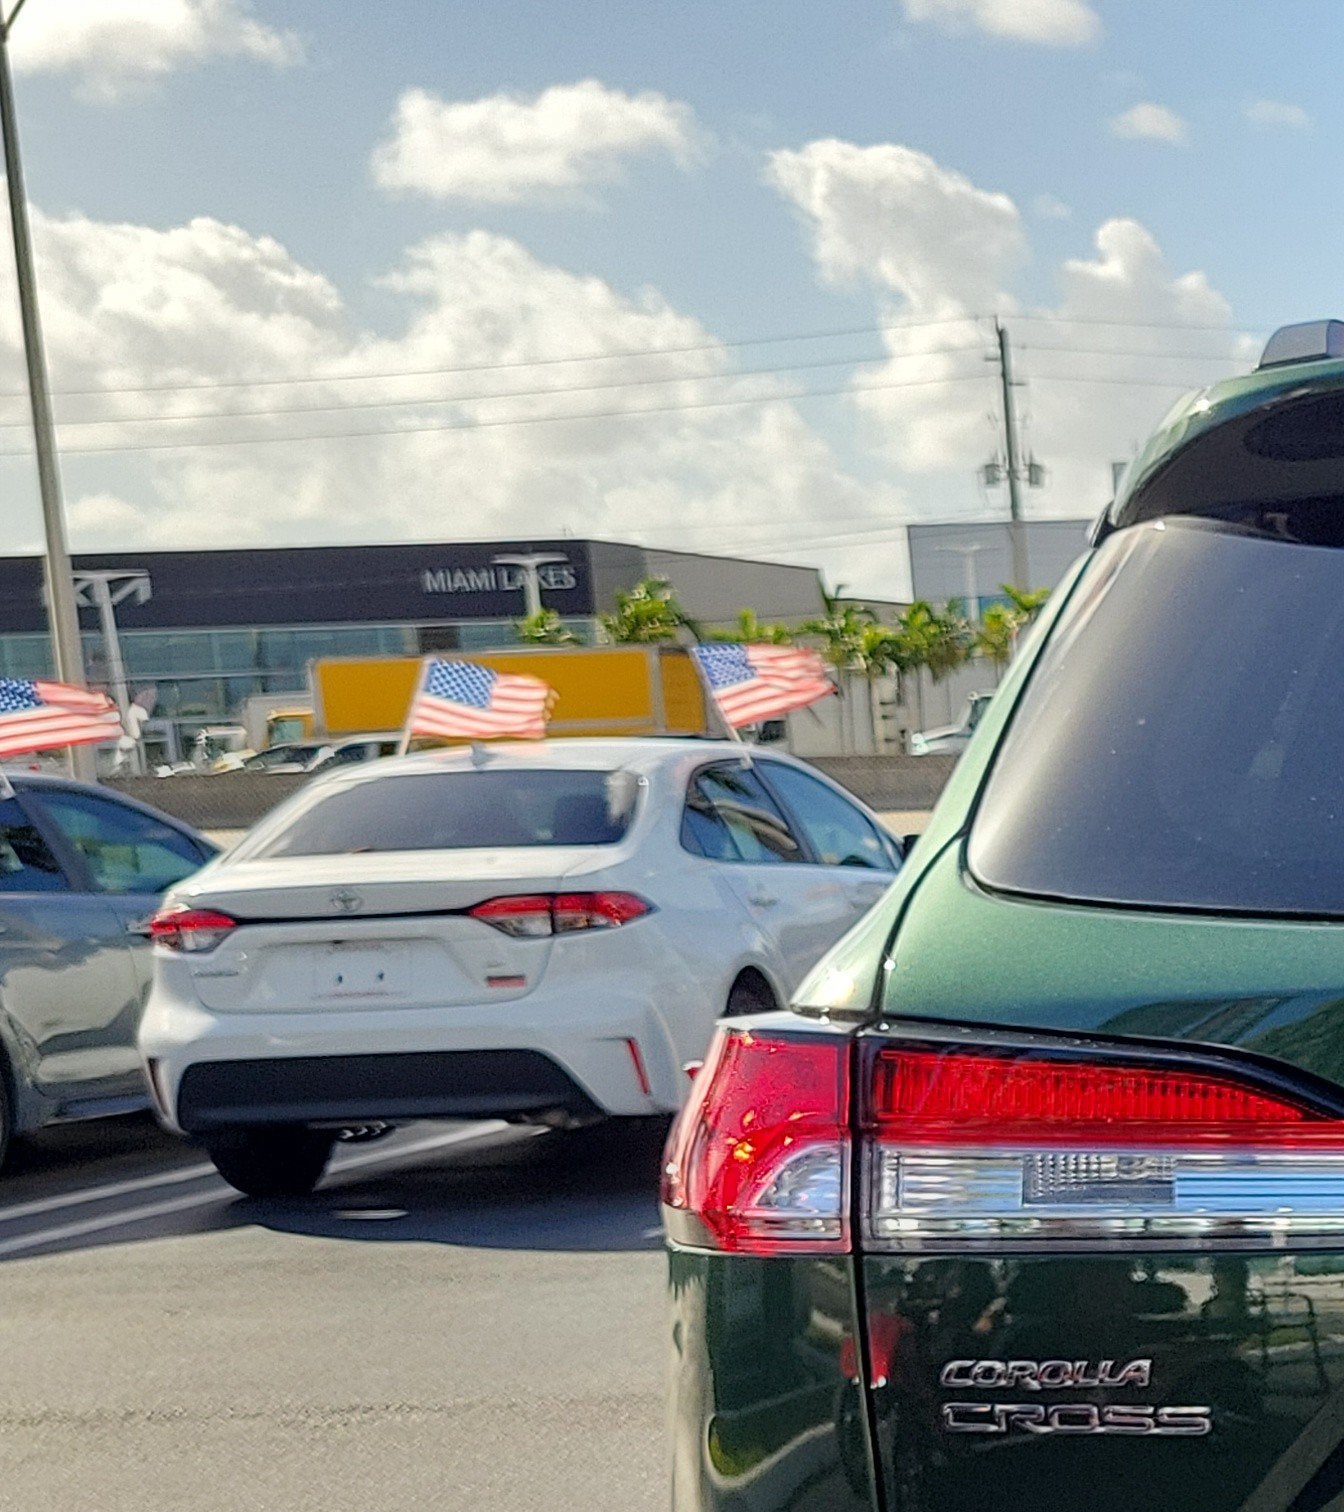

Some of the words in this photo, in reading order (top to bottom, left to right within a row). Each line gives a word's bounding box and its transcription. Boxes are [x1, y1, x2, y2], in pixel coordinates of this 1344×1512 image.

[422, 566, 498, 593] MIAMI
[940, 1358, 1152, 1390] COROLLA
[942, 1402, 1212, 1436] CROSS
